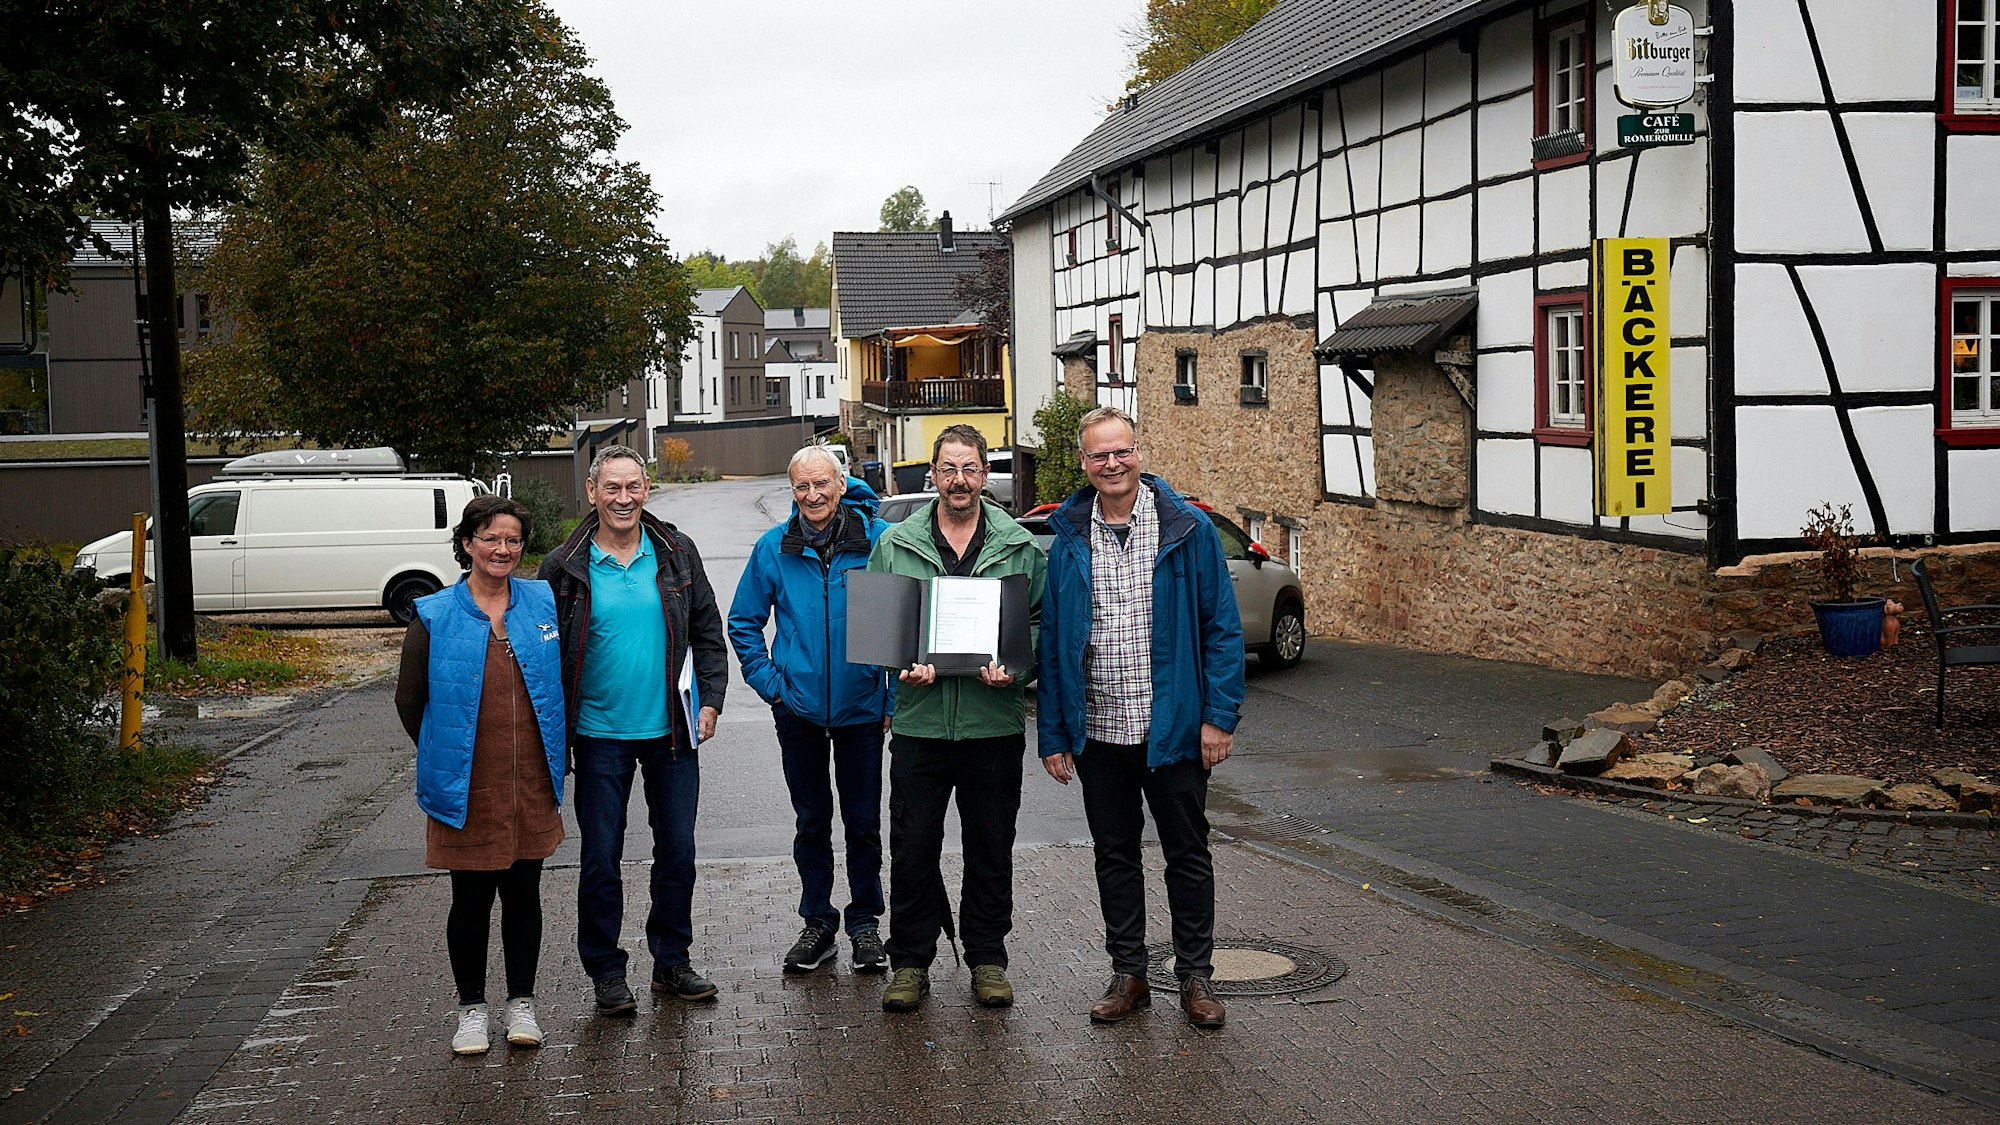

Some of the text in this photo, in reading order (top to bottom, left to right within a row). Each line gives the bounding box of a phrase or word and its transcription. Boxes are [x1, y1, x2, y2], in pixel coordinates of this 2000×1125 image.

[1625, 37, 1691, 62] Bitburger
[1642, 114, 1680, 127] CAFÉ
[1624, 133, 1694, 143] RÖMERQUELLE
[1621, 248, 1657, 509] BÄCKEREI
